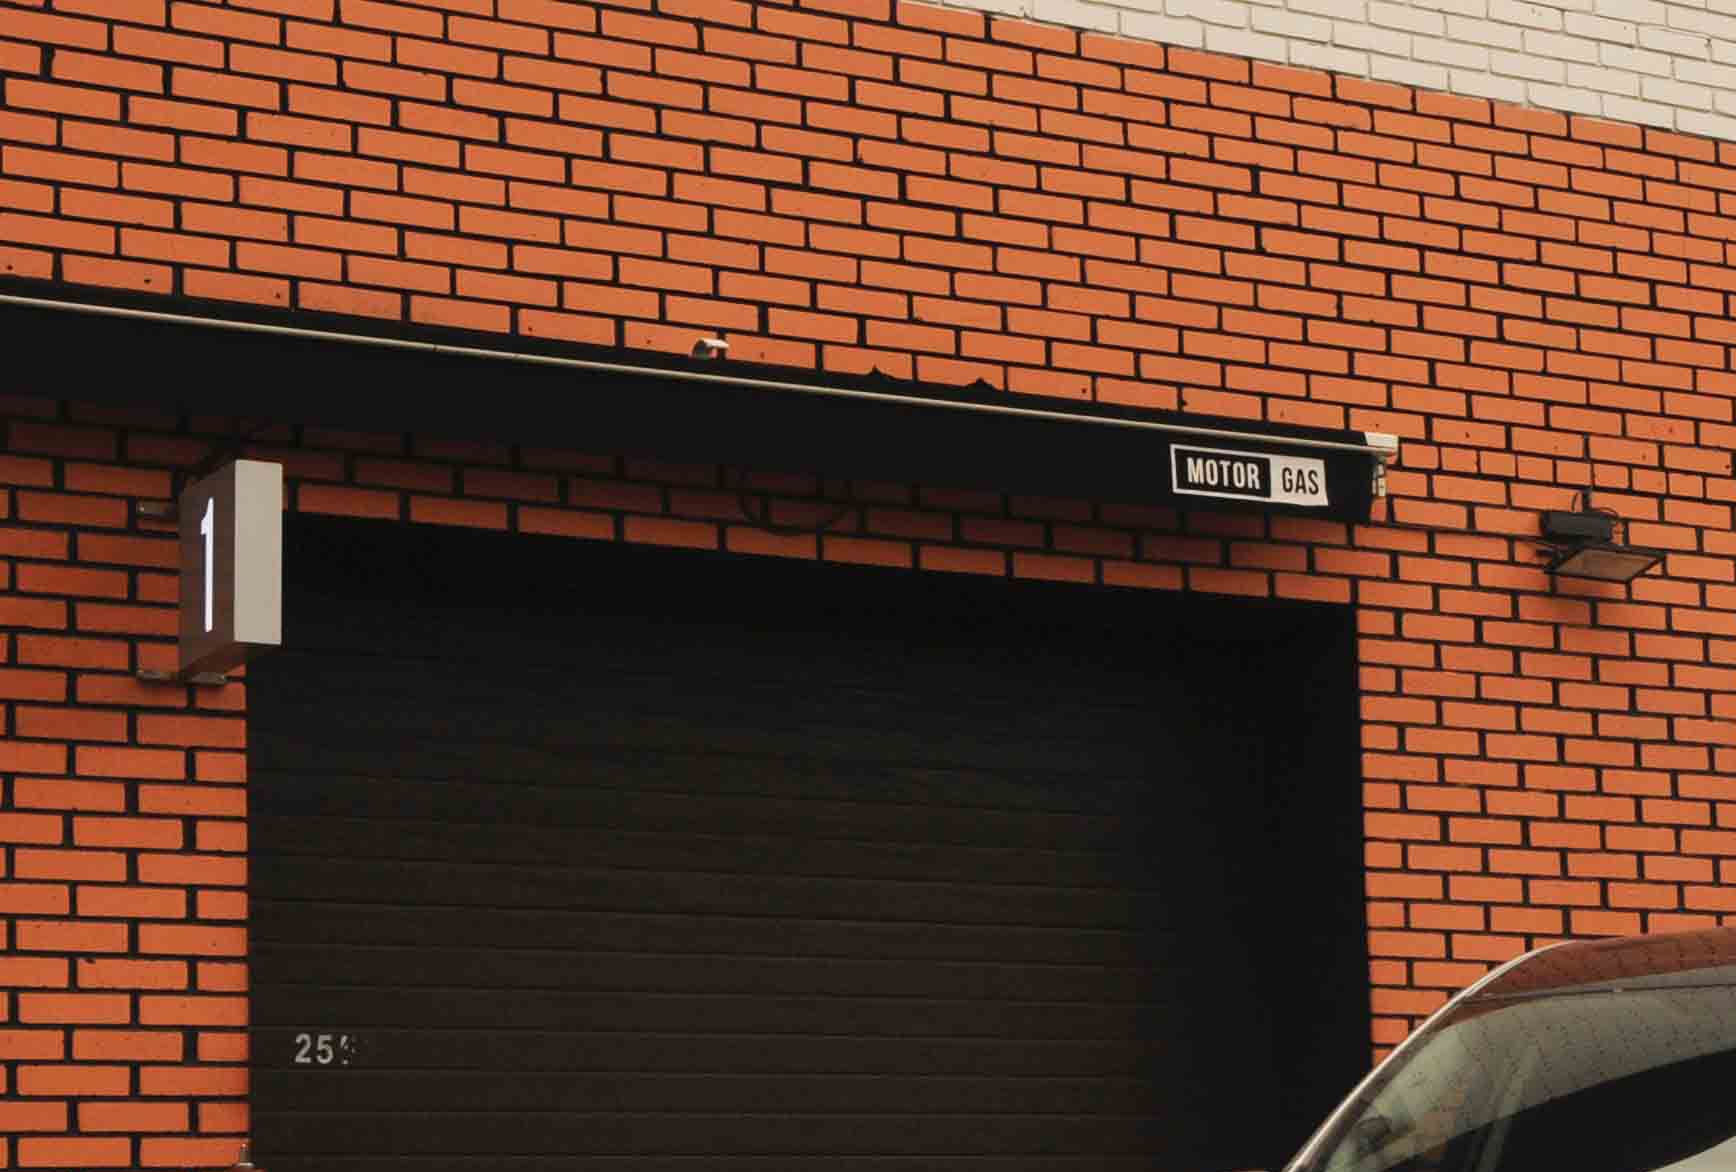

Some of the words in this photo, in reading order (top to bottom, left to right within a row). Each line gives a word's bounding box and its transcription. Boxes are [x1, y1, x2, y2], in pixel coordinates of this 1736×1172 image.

[1186, 457, 1261, 490] MOTOR
[1281, 466, 1320, 495] GAS
[201, 497, 214, 633] 1
